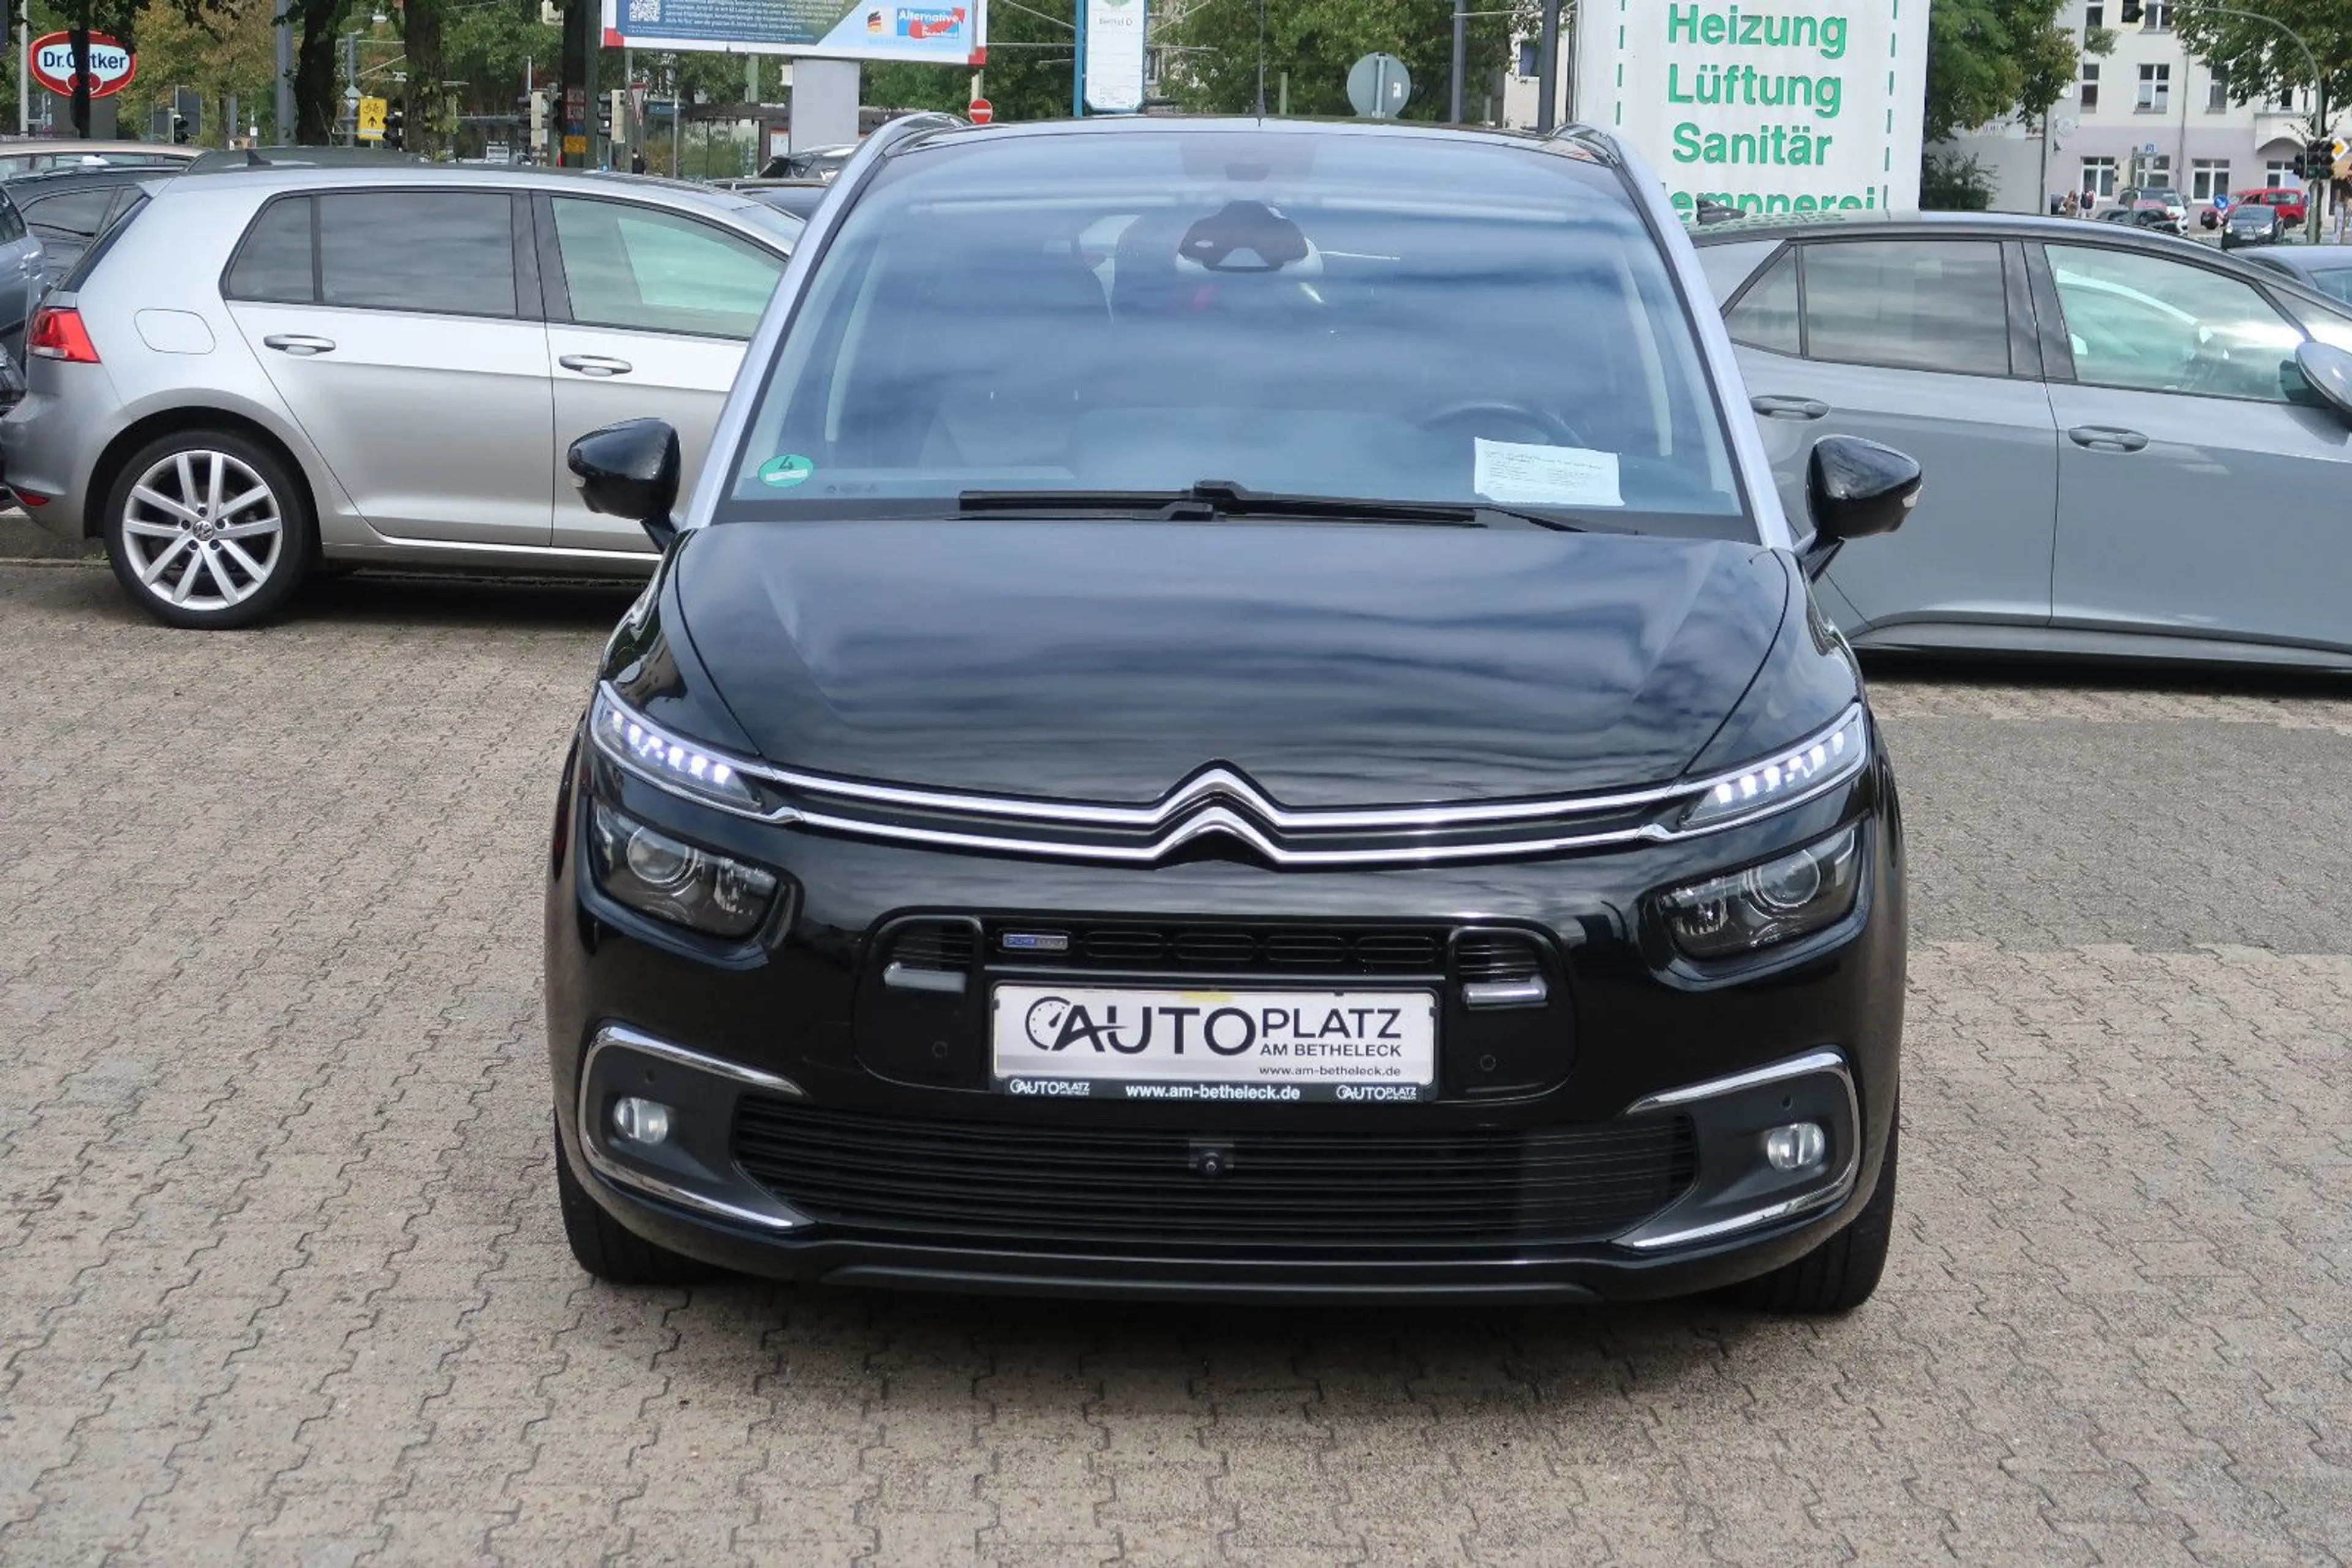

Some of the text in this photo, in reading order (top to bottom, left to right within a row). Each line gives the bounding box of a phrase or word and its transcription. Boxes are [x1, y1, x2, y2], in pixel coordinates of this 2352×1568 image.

[1668, 3, 1847, 59] Heizung
[66, 53, 126, 69] Otker
[1668, 64, 1842, 118] Lüftung
[1673, 123, 1833, 165] Sanitär
[778, 455, 794, 470] 4
[1260, 1043, 1402, 1057] AM BETHELECK
[1259, 1066, 1401, 1077] www.am-betheleck.de
[1126, 1079, 1300, 1099] www.am-betheleck.de
